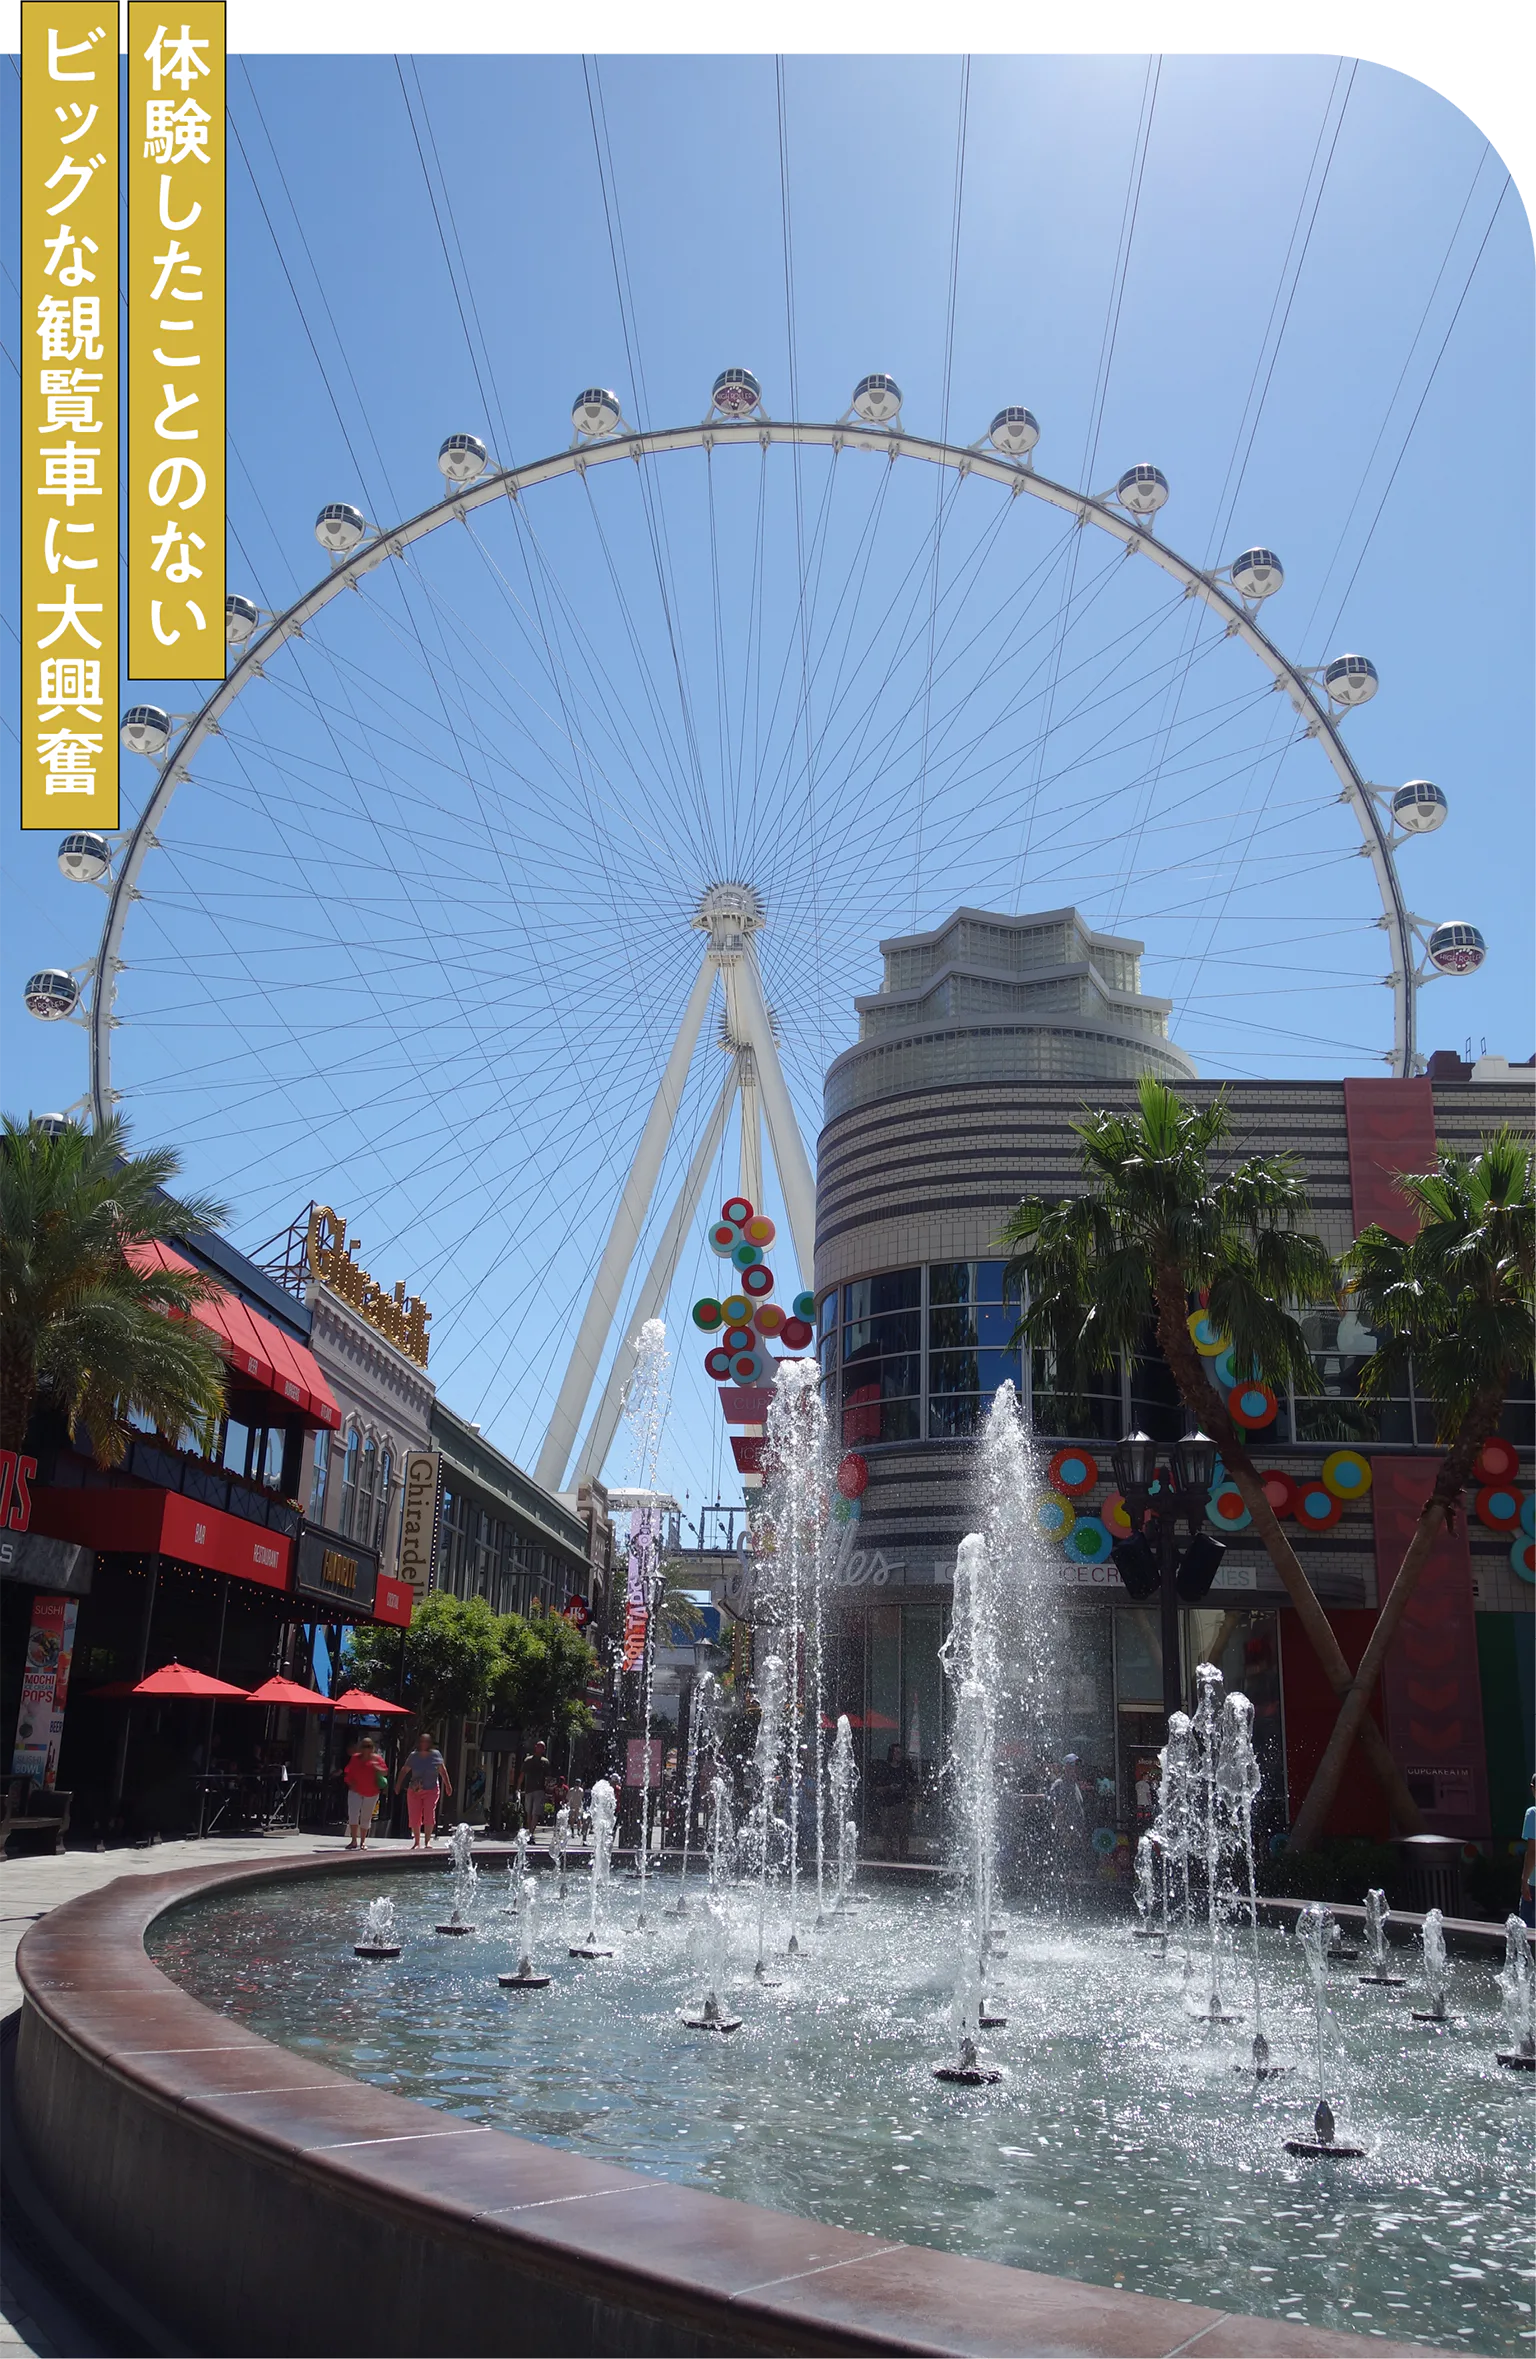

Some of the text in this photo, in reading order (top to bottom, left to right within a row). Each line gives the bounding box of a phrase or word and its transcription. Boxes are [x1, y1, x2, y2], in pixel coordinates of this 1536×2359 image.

[194, 1522, 207, 1545] BAR
[252, 1543, 280, 1569] RESTAURANT
[34, 1604, 64, 1616] SUSHI
[24, 1674, 55, 1685] MOCHI
[22, 1690, 54, 1703] POPS
[14, 1763, 41, 1774] BOWL
